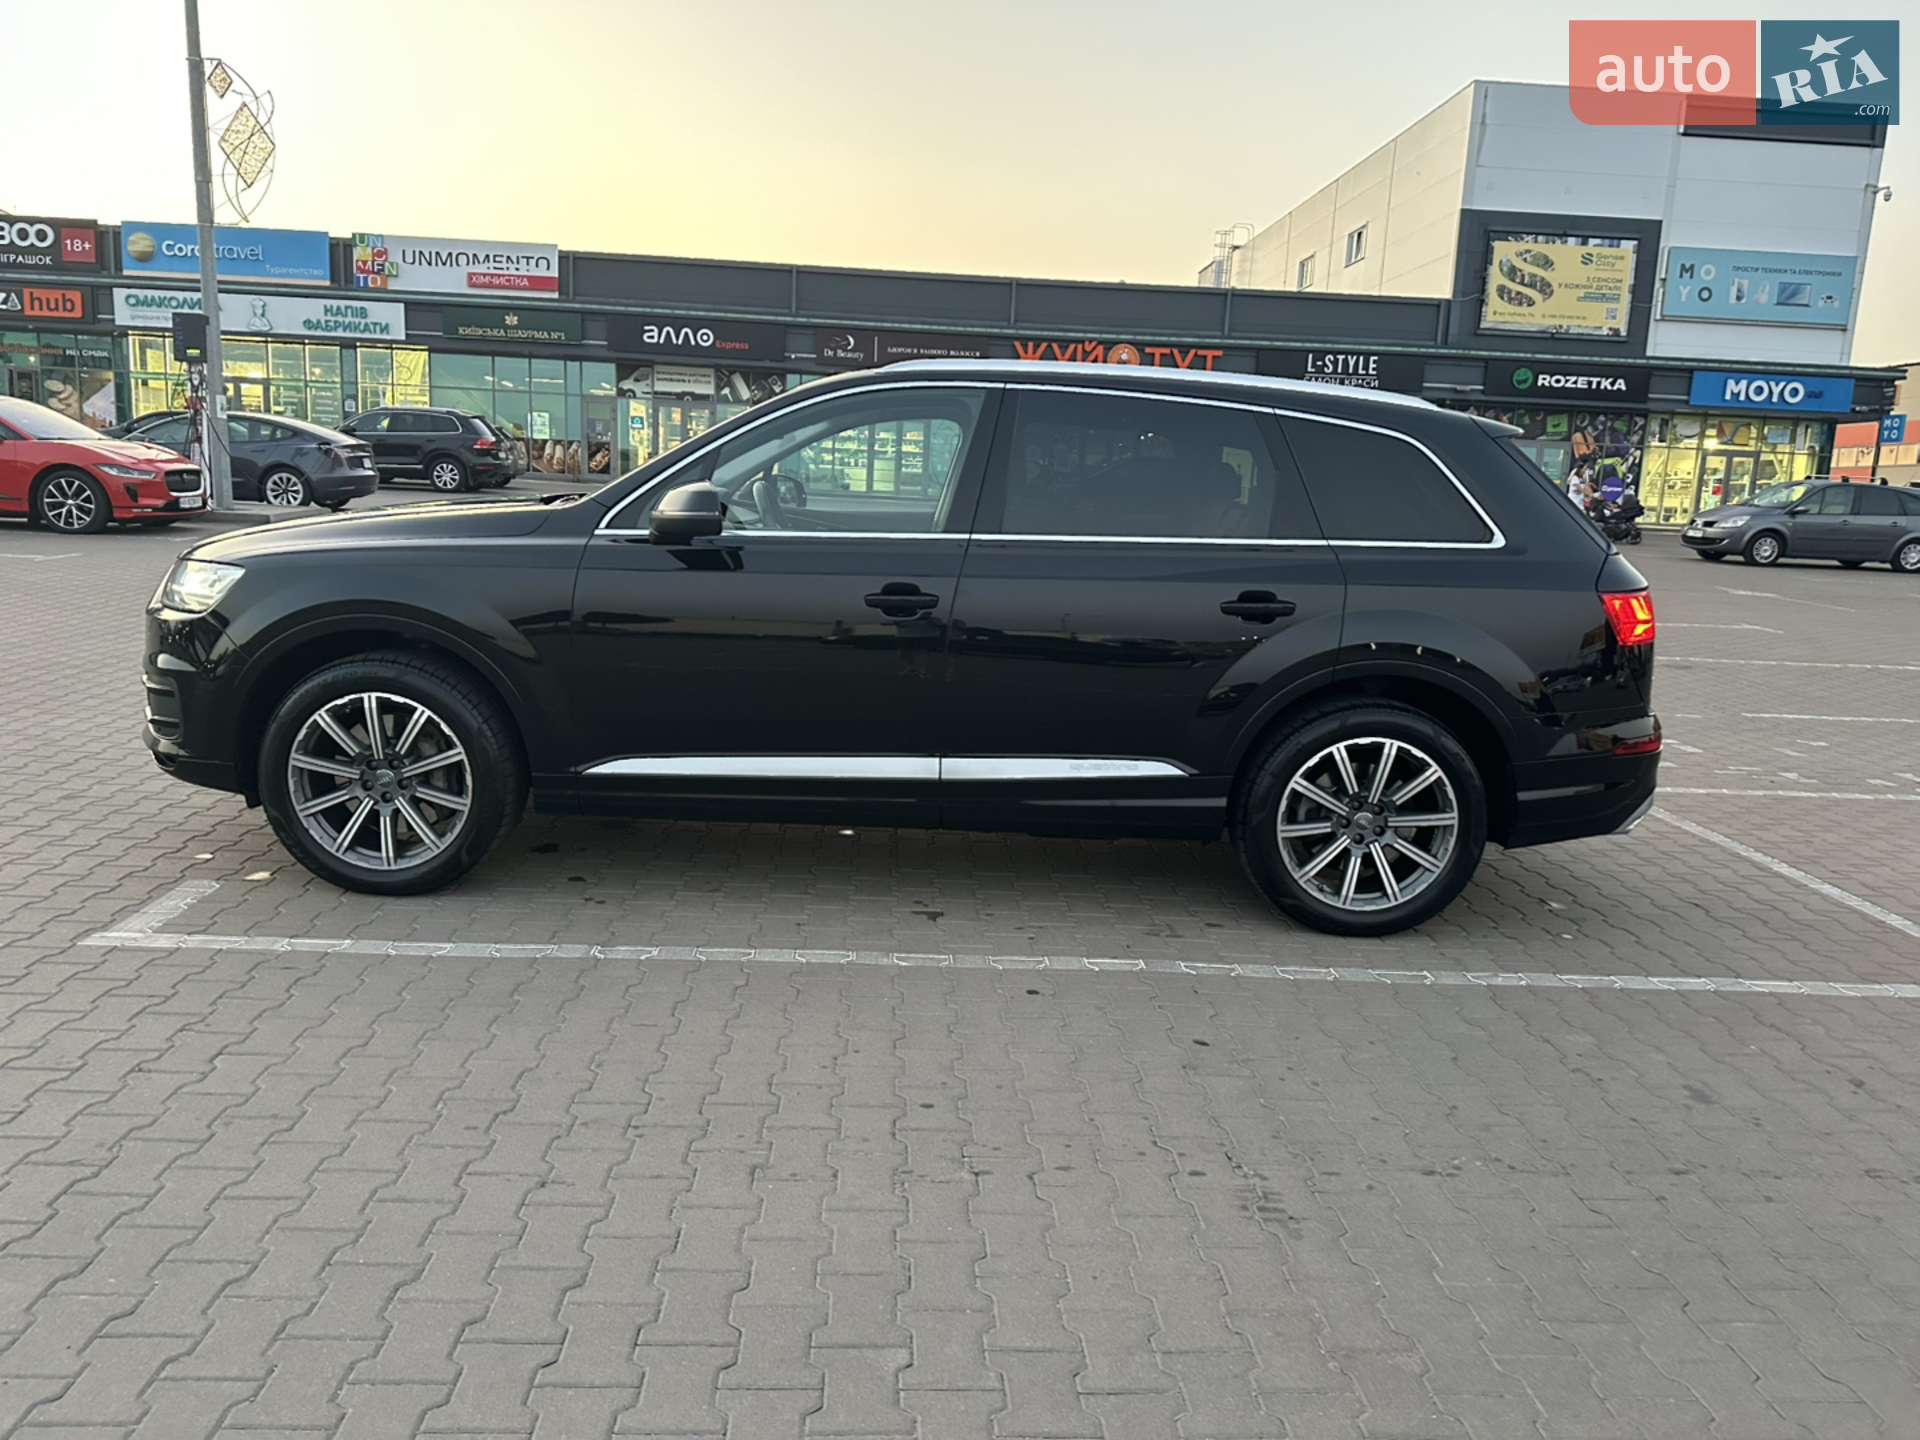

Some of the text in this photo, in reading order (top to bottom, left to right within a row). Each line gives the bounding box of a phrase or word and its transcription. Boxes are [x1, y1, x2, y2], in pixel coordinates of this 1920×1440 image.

[65, 238, 92, 252] 18+
[355, 234, 382, 247] UN
[162, 240, 200, 257] Cor
[402, 249, 551, 272] UNMOMENTO
[265, 264, 324, 276] Турагентство
[358, 274, 382, 288] TO
[471, 274, 530, 287] ХІМЧИСТКА
[29, 291, 76, 313] hub
[125, 293, 223, 312] СМАКОЛИ
[323, 304, 369, 319] НАПІВ
[302, 318, 390, 335] ФАБРИКАТИ
[458, 325, 506, 337] КИЇВСЬКА
[507, 329, 549, 339] ШАУРМА
[715, 340, 750, 350] Express
[81, 348, 109, 358] смак
[823, 348, 865, 362] Dr Beauty
[1144, 347, 1223, 371] ТУТ
[1307, 353, 1379, 375] L-STYLE
[1537, 374, 1626, 391] ROZETKA
[1724, 378, 1805, 404] MOYO
[1069, 762, 1140, 772] quattro
